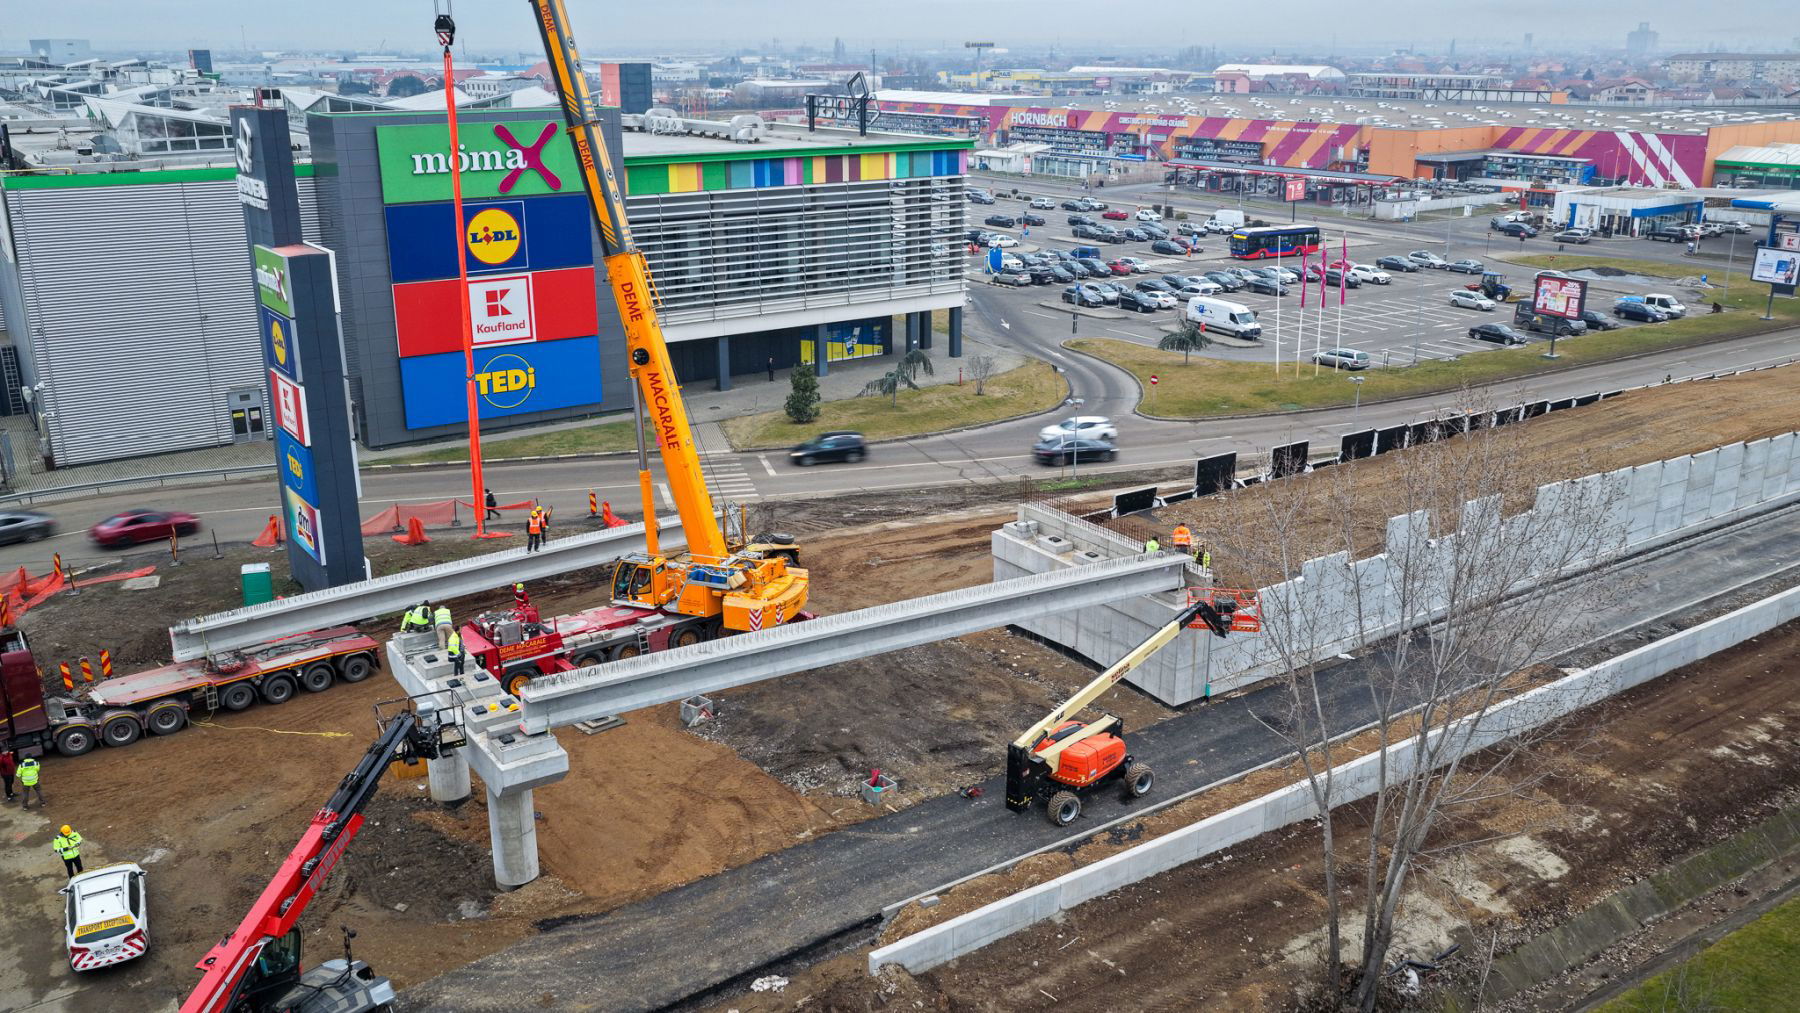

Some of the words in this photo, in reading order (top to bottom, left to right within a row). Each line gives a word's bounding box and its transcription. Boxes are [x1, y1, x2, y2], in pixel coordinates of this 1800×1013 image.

[541, 5, 556, 33] DEME
[1011, 112, 1067, 127] HORNBACH
[578, 139, 594, 171] DEME
[477, 320, 525, 333] Kaufland
[621, 282, 643, 322] DEME
[647, 372, 680, 450] MACARALE
[475, 367, 536, 395] TEDi
[500, 645, 514, 653] DEME
[516, 638, 546, 650] MACARALE
[309, 827, 351, 891] MANITOU
[78, 923, 102, 935] TRANSPORT
